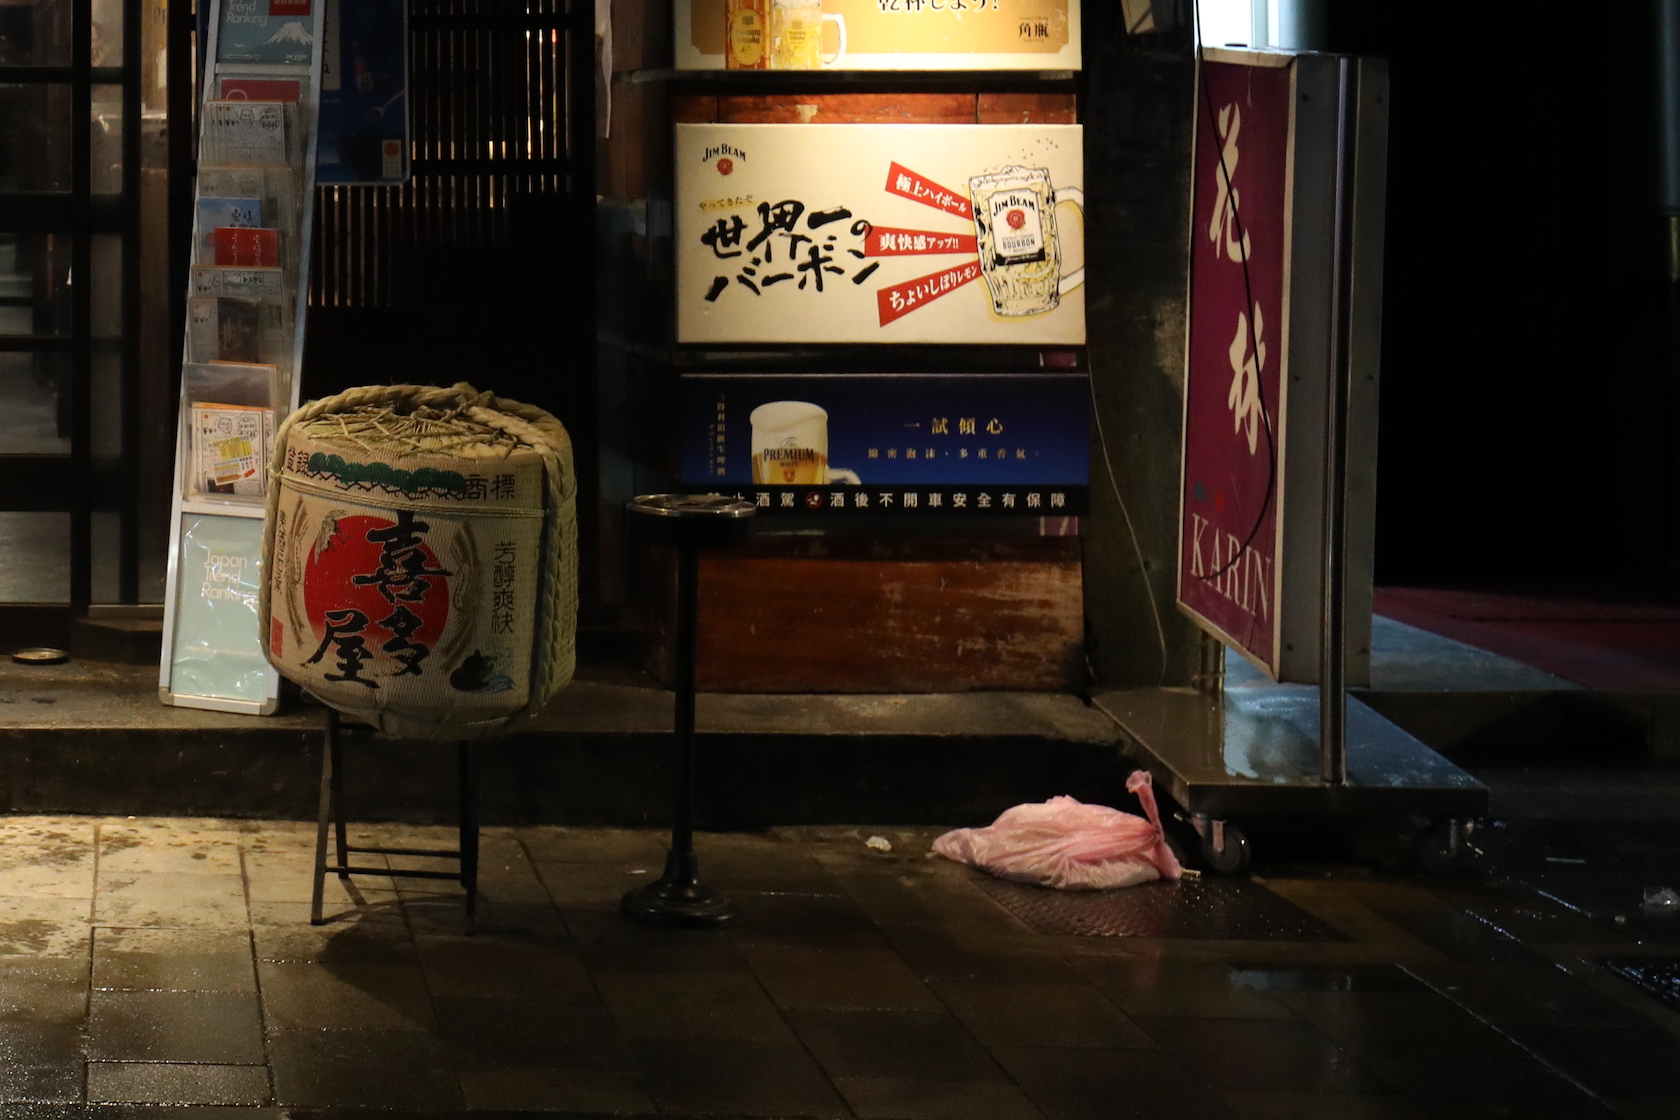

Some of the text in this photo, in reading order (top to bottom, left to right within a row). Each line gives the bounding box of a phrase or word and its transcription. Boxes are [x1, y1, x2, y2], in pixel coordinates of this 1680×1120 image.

[229, 0, 256, 12] Trend
[226, 11, 267, 27] Ranking
[702, 143, 747, 162] JIM BEAM
[896, 172, 967, 212] 極上ハイボール
[993, 195, 1036, 217] JIM BEAM
[1002, 239, 1036, 250] BOURBON
[889, 264, 979, 311] ちょいしぼりレモン
[904, 418, 1003, 435] 一試傾心
[763, 448, 814, 461] PREMIUM
[464, 474, 516, 501] 商標
[830, 491, 1066, 508] 酒後不開車安全有保障
[204, 550, 248, 567] Japan
[1191, 513, 1271, 621] KARIN
[205, 566, 241, 583] Trend
[491, 541, 516, 634] 芳醇爽快
[299, 510, 454, 688] 喜多屋
